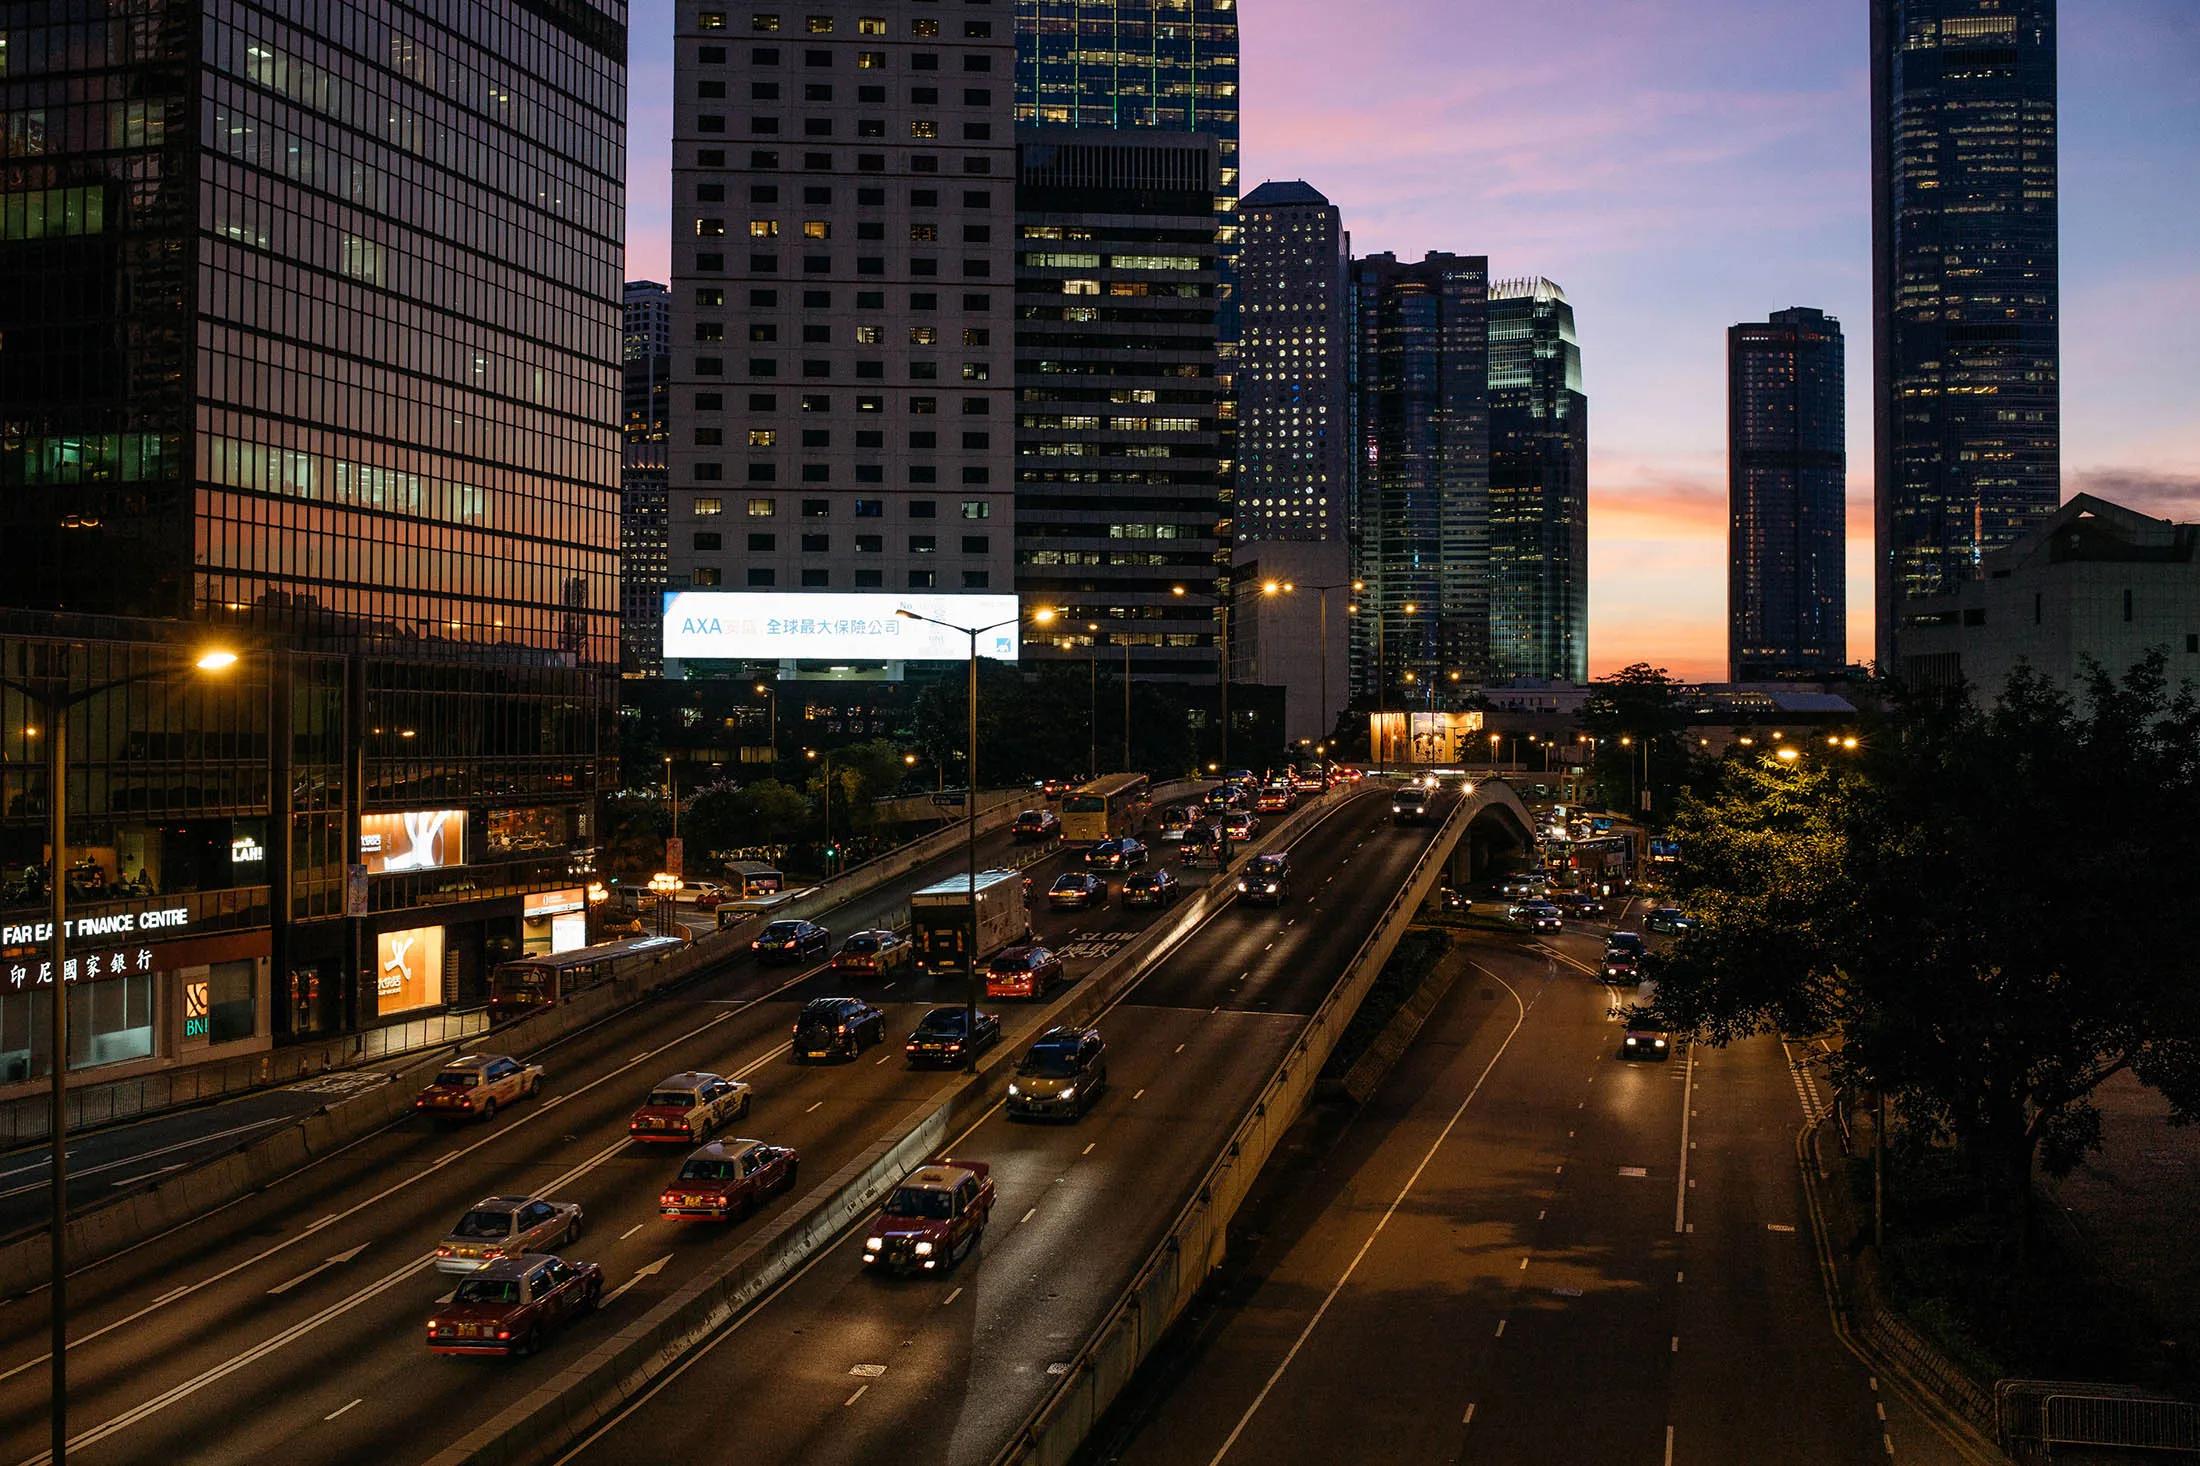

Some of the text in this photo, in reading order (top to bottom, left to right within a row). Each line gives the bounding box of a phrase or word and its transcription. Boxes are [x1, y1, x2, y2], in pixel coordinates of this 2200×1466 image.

[681, 617, 723, 635] AXA
[766, 618, 900, 636] 全球最大保險公司
[232, 846, 263, 862] LAH!
[3, 908, 188, 945] FAR EAT FINANCE CENTRE
[10, 948, 153, 989] 印尼國家銀行
[186, 1017, 209, 1037] BNI
